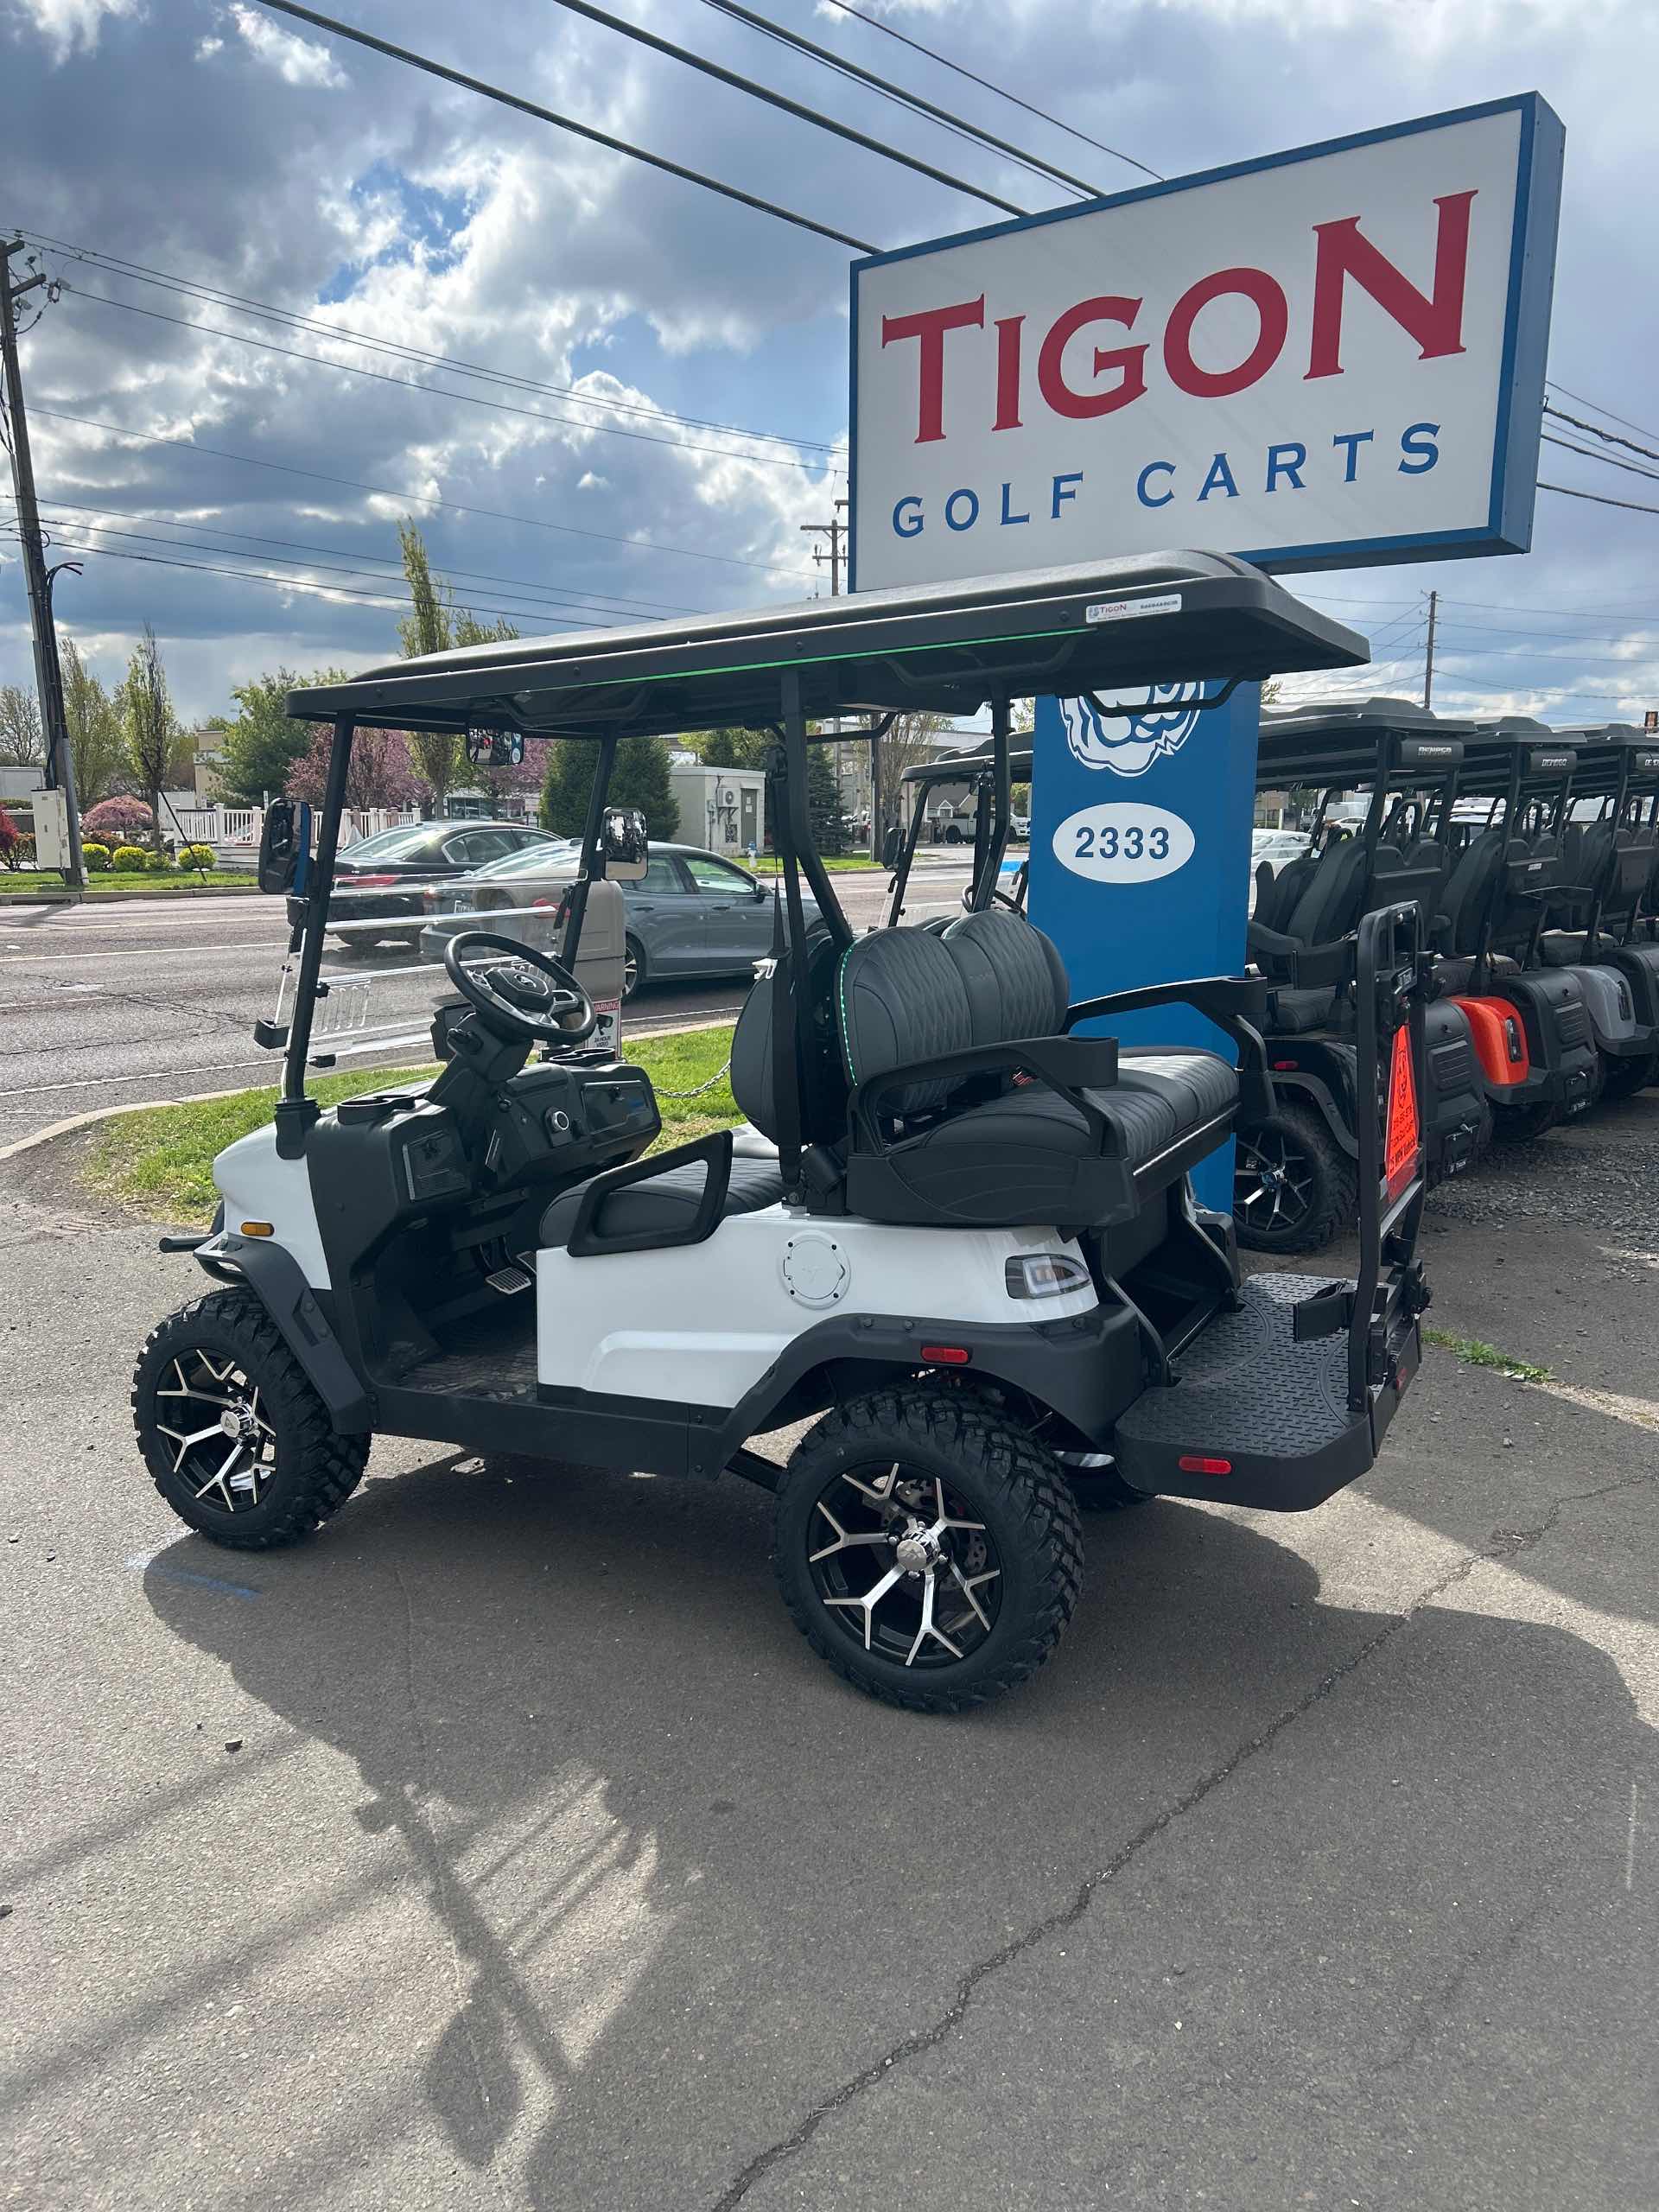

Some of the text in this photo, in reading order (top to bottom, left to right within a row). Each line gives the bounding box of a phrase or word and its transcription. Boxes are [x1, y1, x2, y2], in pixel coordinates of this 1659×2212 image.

[882, 189, 1478, 443] TIGON
[893, 422, 1441, 538] GOLF CARTS
[1099, 603, 1127, 613] TIGON
[1075, 827, 1170, 859] 2333
